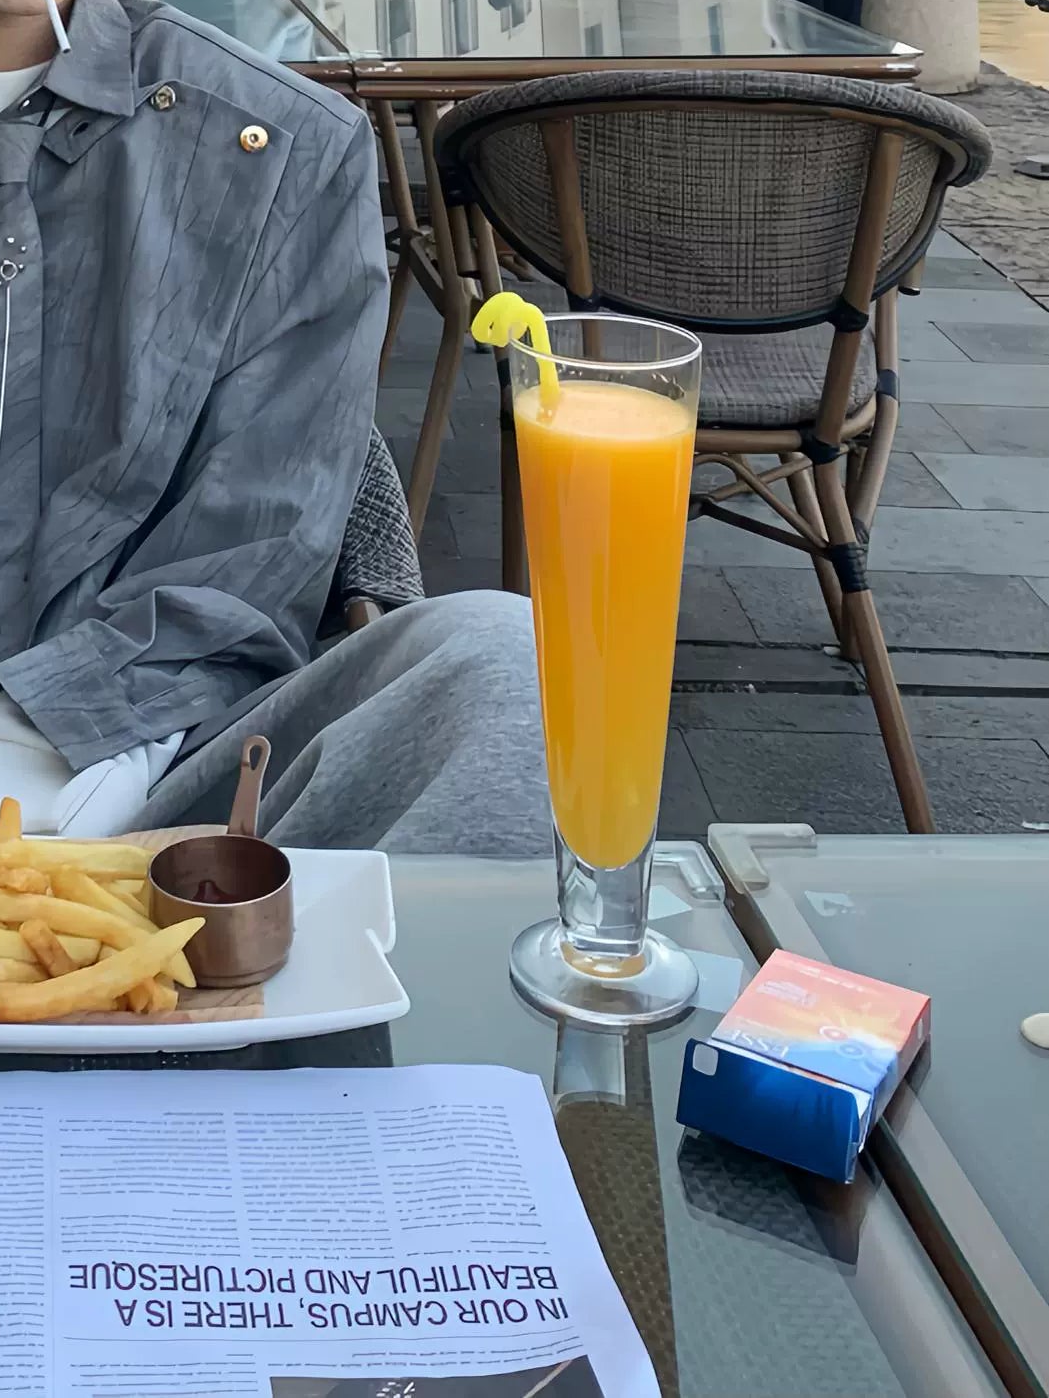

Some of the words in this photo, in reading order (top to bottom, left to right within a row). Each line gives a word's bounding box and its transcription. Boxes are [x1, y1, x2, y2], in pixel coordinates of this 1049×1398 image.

[68, 1260, 297, 1294] PICTURESQUE
[304, 1268, 372, 1296] AND
[376, 1263, 559, 1295] BEAUTIFUL
[113, 1298, 138, 1327] A
[144, 1299, 174, 1329] IS
[181, 1300, 294, 1329] THERE
[298, 1297, 448, 1329] CAMPUS,
[453, 1298, 529, 1325] OUR
[534, 1297, 569, 1322] IN
